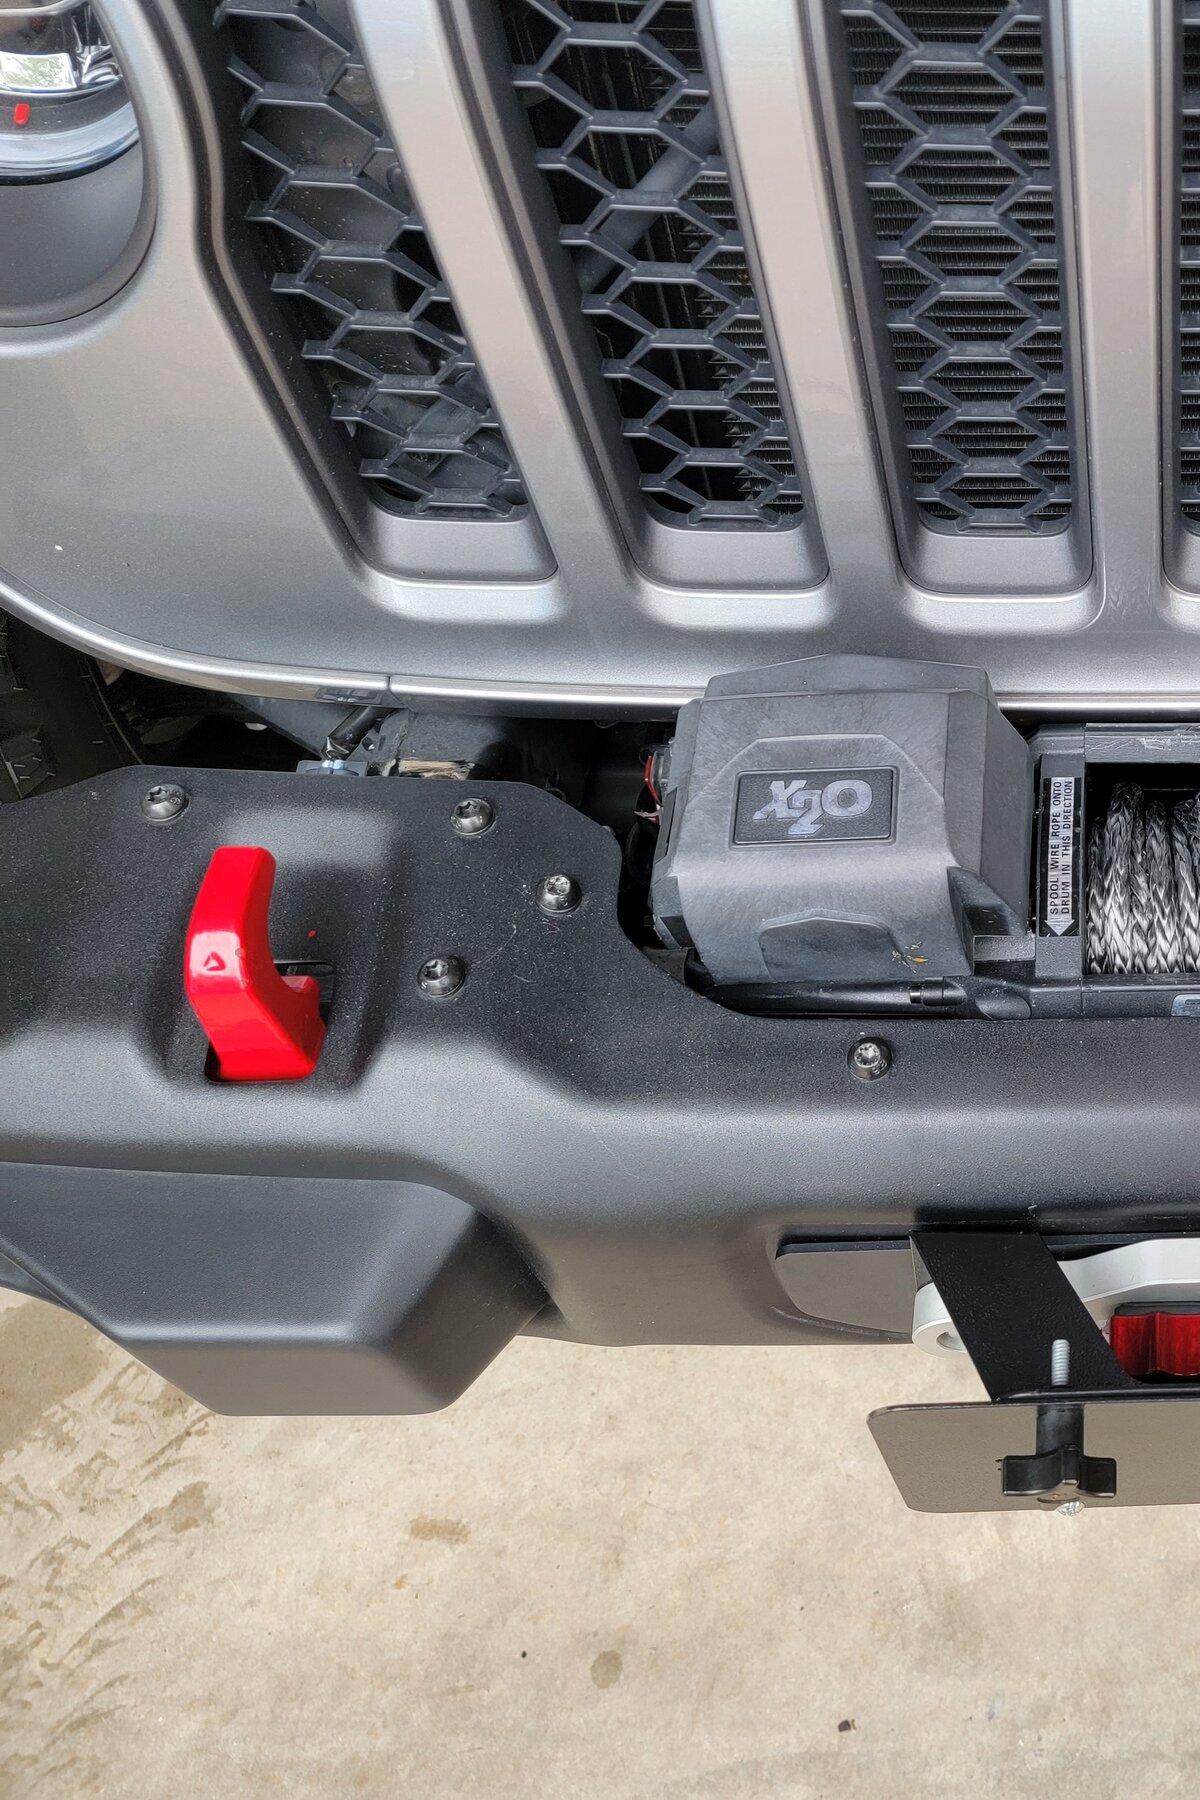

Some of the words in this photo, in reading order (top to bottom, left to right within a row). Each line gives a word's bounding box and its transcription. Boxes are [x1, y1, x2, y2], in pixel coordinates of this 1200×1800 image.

[1052, 781, 1062, 806] ONTO
[1062, 780, 1073, 829] DIRECTION
[1051, 812, 1061, 837] ROPE
[1050, 843, 1060, 870] WIRE
[1062, 835, 1071, 858] THIS
[1062, 864, 1070, 875] IN
[1049, 877, 1059, 914] SPOOL
[1061, 882, 1070, 914] DRUM
